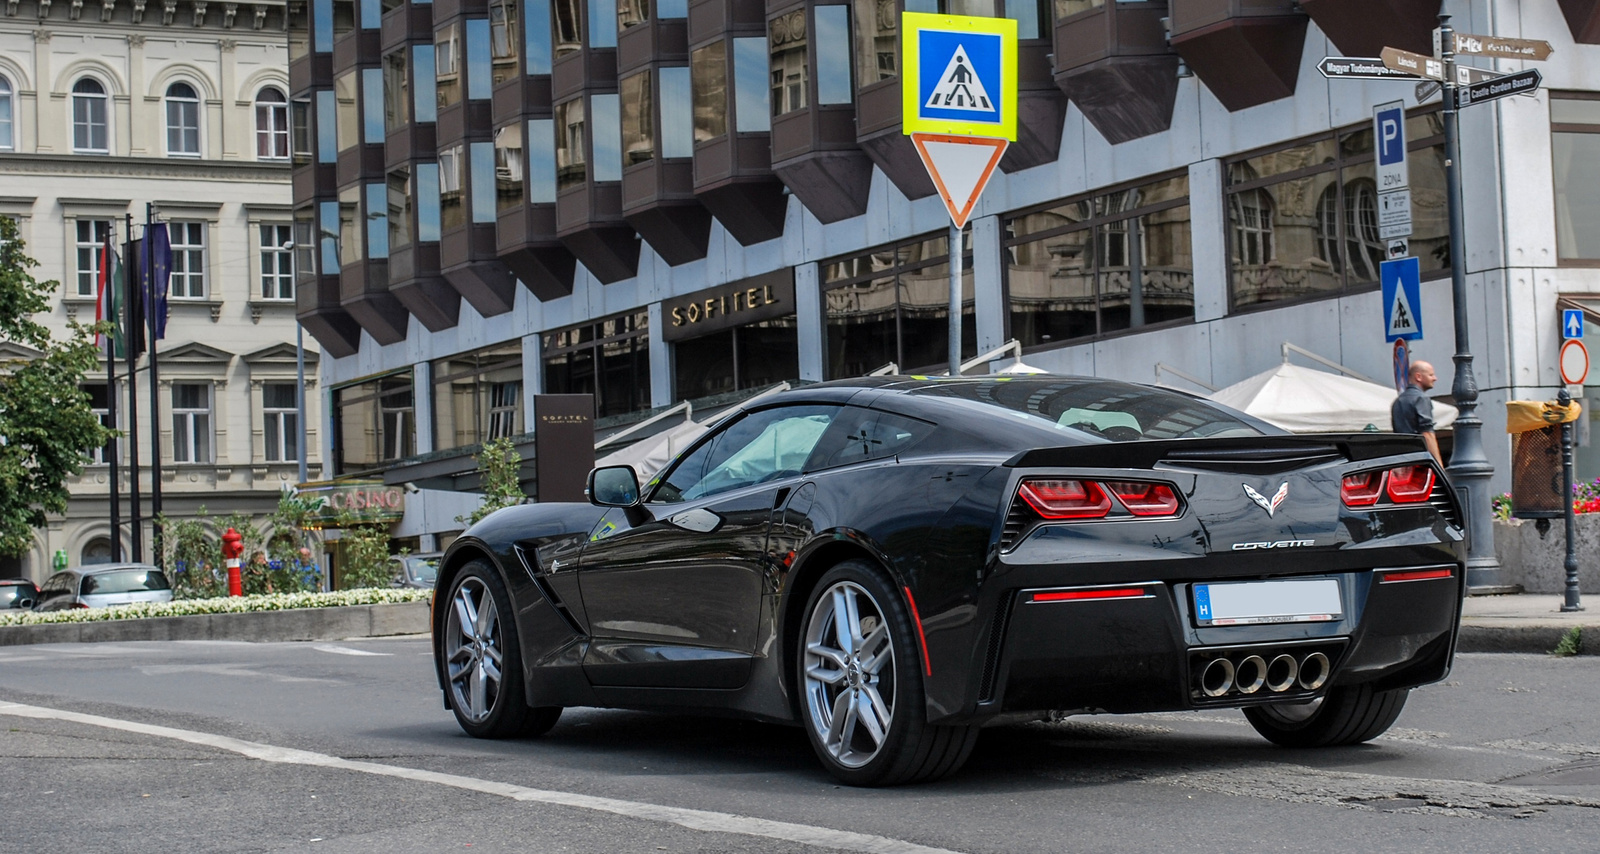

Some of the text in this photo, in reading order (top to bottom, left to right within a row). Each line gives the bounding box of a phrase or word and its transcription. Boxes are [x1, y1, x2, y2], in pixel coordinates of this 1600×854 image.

[1326, 62, 1350, 74] Magyar
[1350, 63, 1389, 75] Tudományos
[1471, 86, 1490, 99] Castle
[1489, 82, 1512, 94] Garden
[1511, 77, 1534, 88] Bazaar
[1382, 119, 1397, 156] P
[671, 285, 776, 327] SOFITEL
[330, 489, 401, 511] CASINO
[1232, 539, 1316, 551] CORVETTE
[1200, 605, 1208, 615] H
